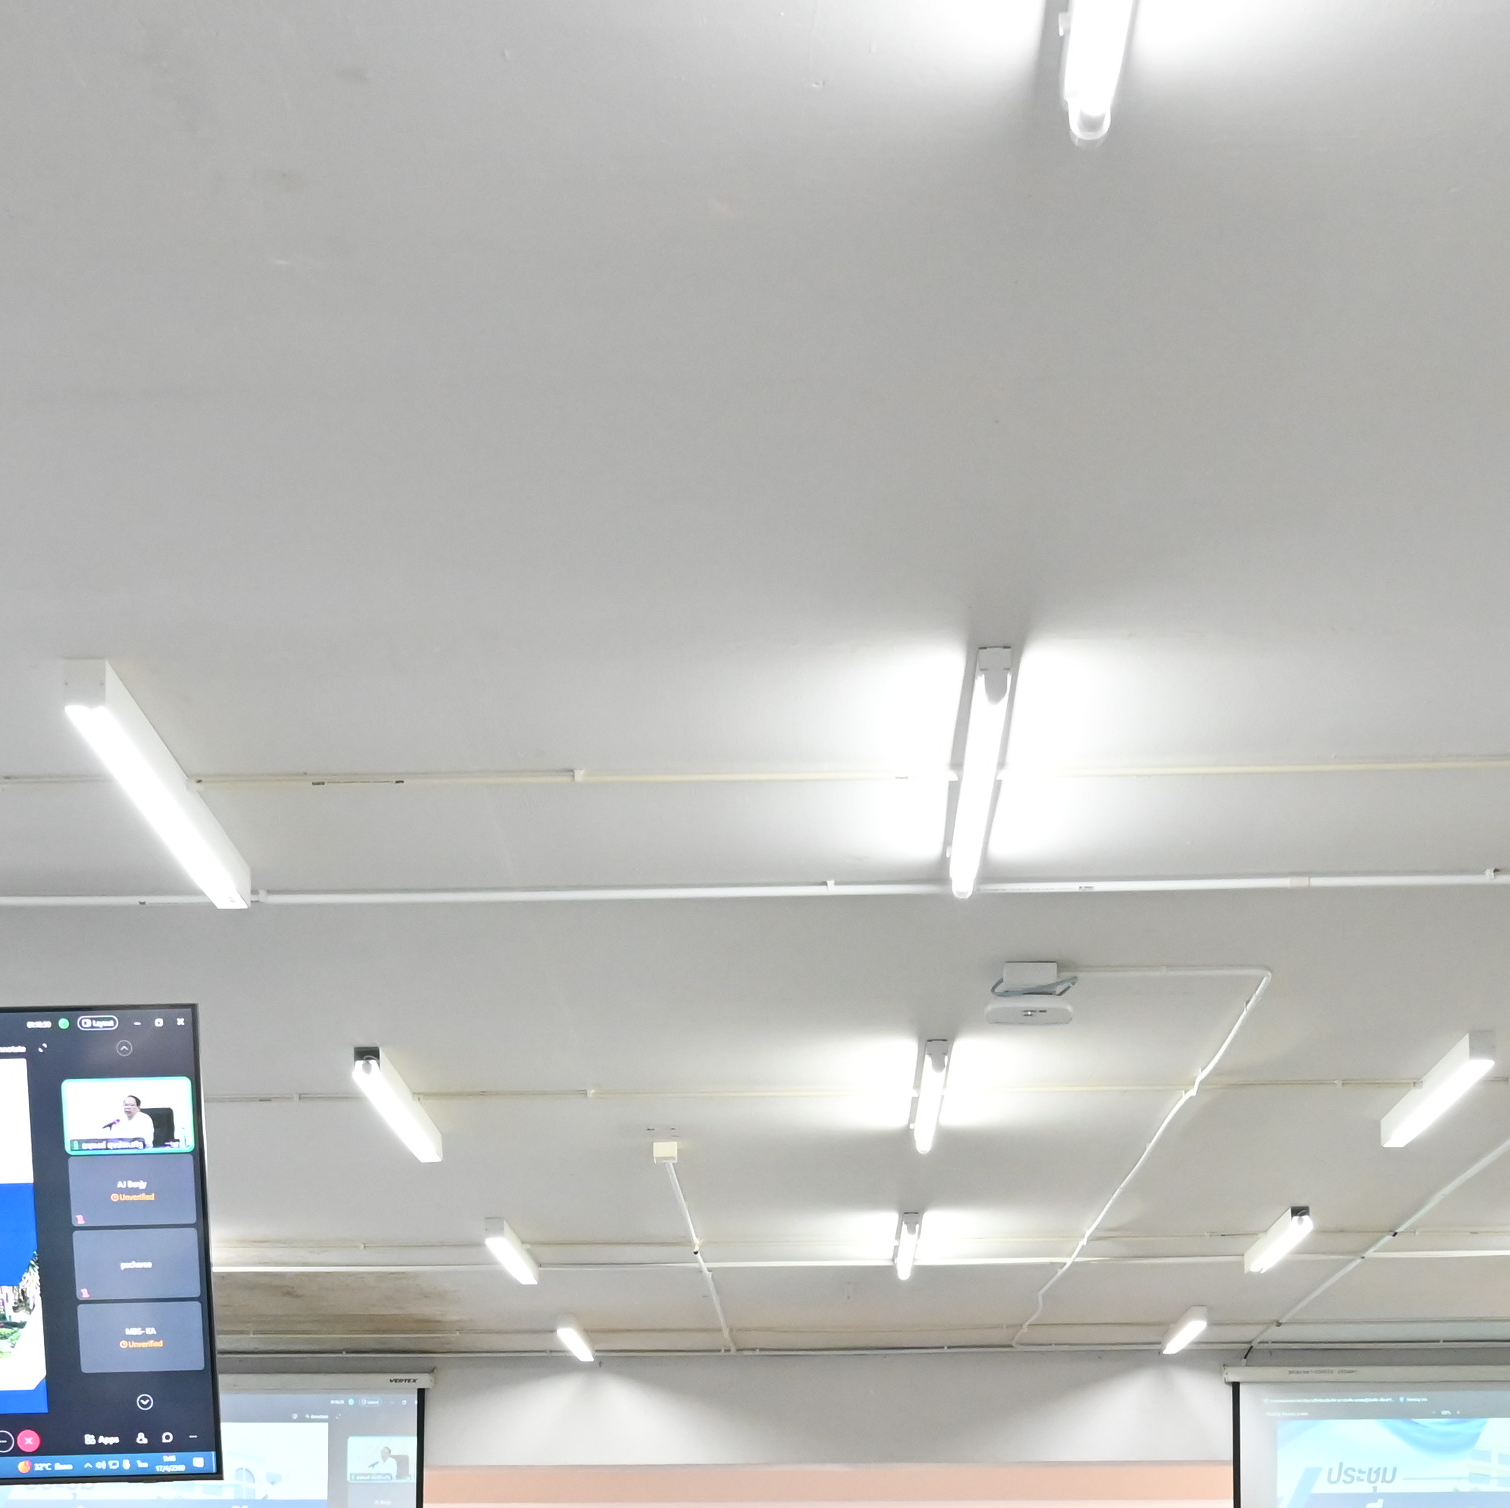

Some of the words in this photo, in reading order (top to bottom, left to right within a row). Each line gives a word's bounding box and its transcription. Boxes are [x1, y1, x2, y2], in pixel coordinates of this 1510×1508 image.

[98, 1435, 119, 1446] Apps
[1327, 1462, 1397, 1493] ประชุม
